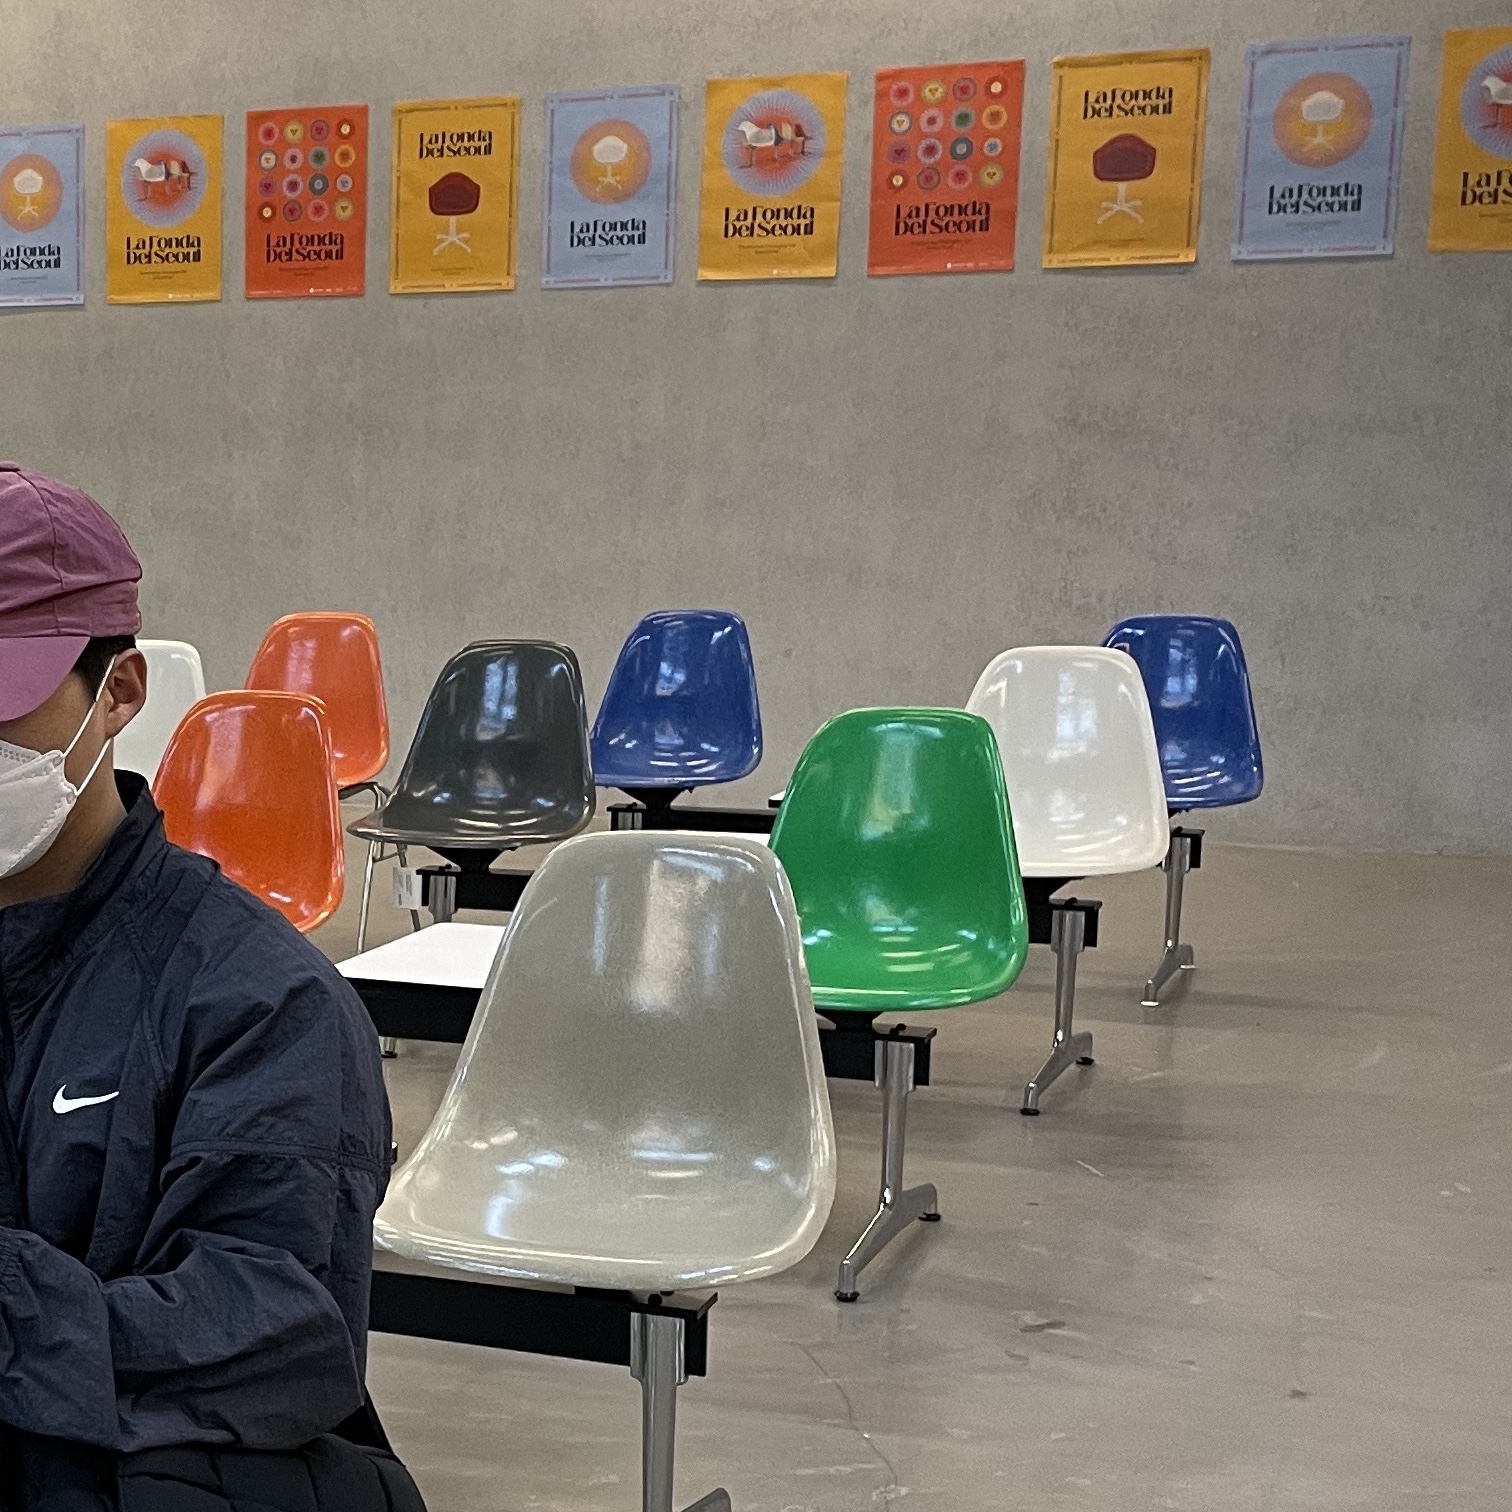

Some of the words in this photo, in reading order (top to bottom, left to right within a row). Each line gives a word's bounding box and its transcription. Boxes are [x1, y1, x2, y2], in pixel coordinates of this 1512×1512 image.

[1083, 88, 1108, 105] La
[1110, 86, 1173, 106] Fonda
[1114, 101, 1173, 119] Seoul
[419, 131, 439, 146] La
[441, 129, 492, 146] Fonda
[445, 143, 492, 158] Seoul
[1462, 171, 1491, 189] La
[1268, 184, 1294, 200] La
[1297, 182, 1363, 201] Fonda
[724, 207, 749, 223] La
[752, 204, 815, 224] Fonda
[894, 203, 921, 220] La
[924, 200, 990, 221] Fonda
[1301, 197, 1363, 214] Seoul
[570, 220, 591, 234] La
[593, 218, 647, 235] Fonda
[756, 220, 815, 237] Seoul
[928, 216, 990, 235] Seoul
[126, 237, 147, 251] La
[149, 234, 201, 252] Fonda
[266, 233, 288, 249] La
[290, 231, 344, 250] Fonda
[597, 231, 647, 247] Seoul
[153, 248, 201, 264] Seoul
[293, 246, 344, 263] Seoul
